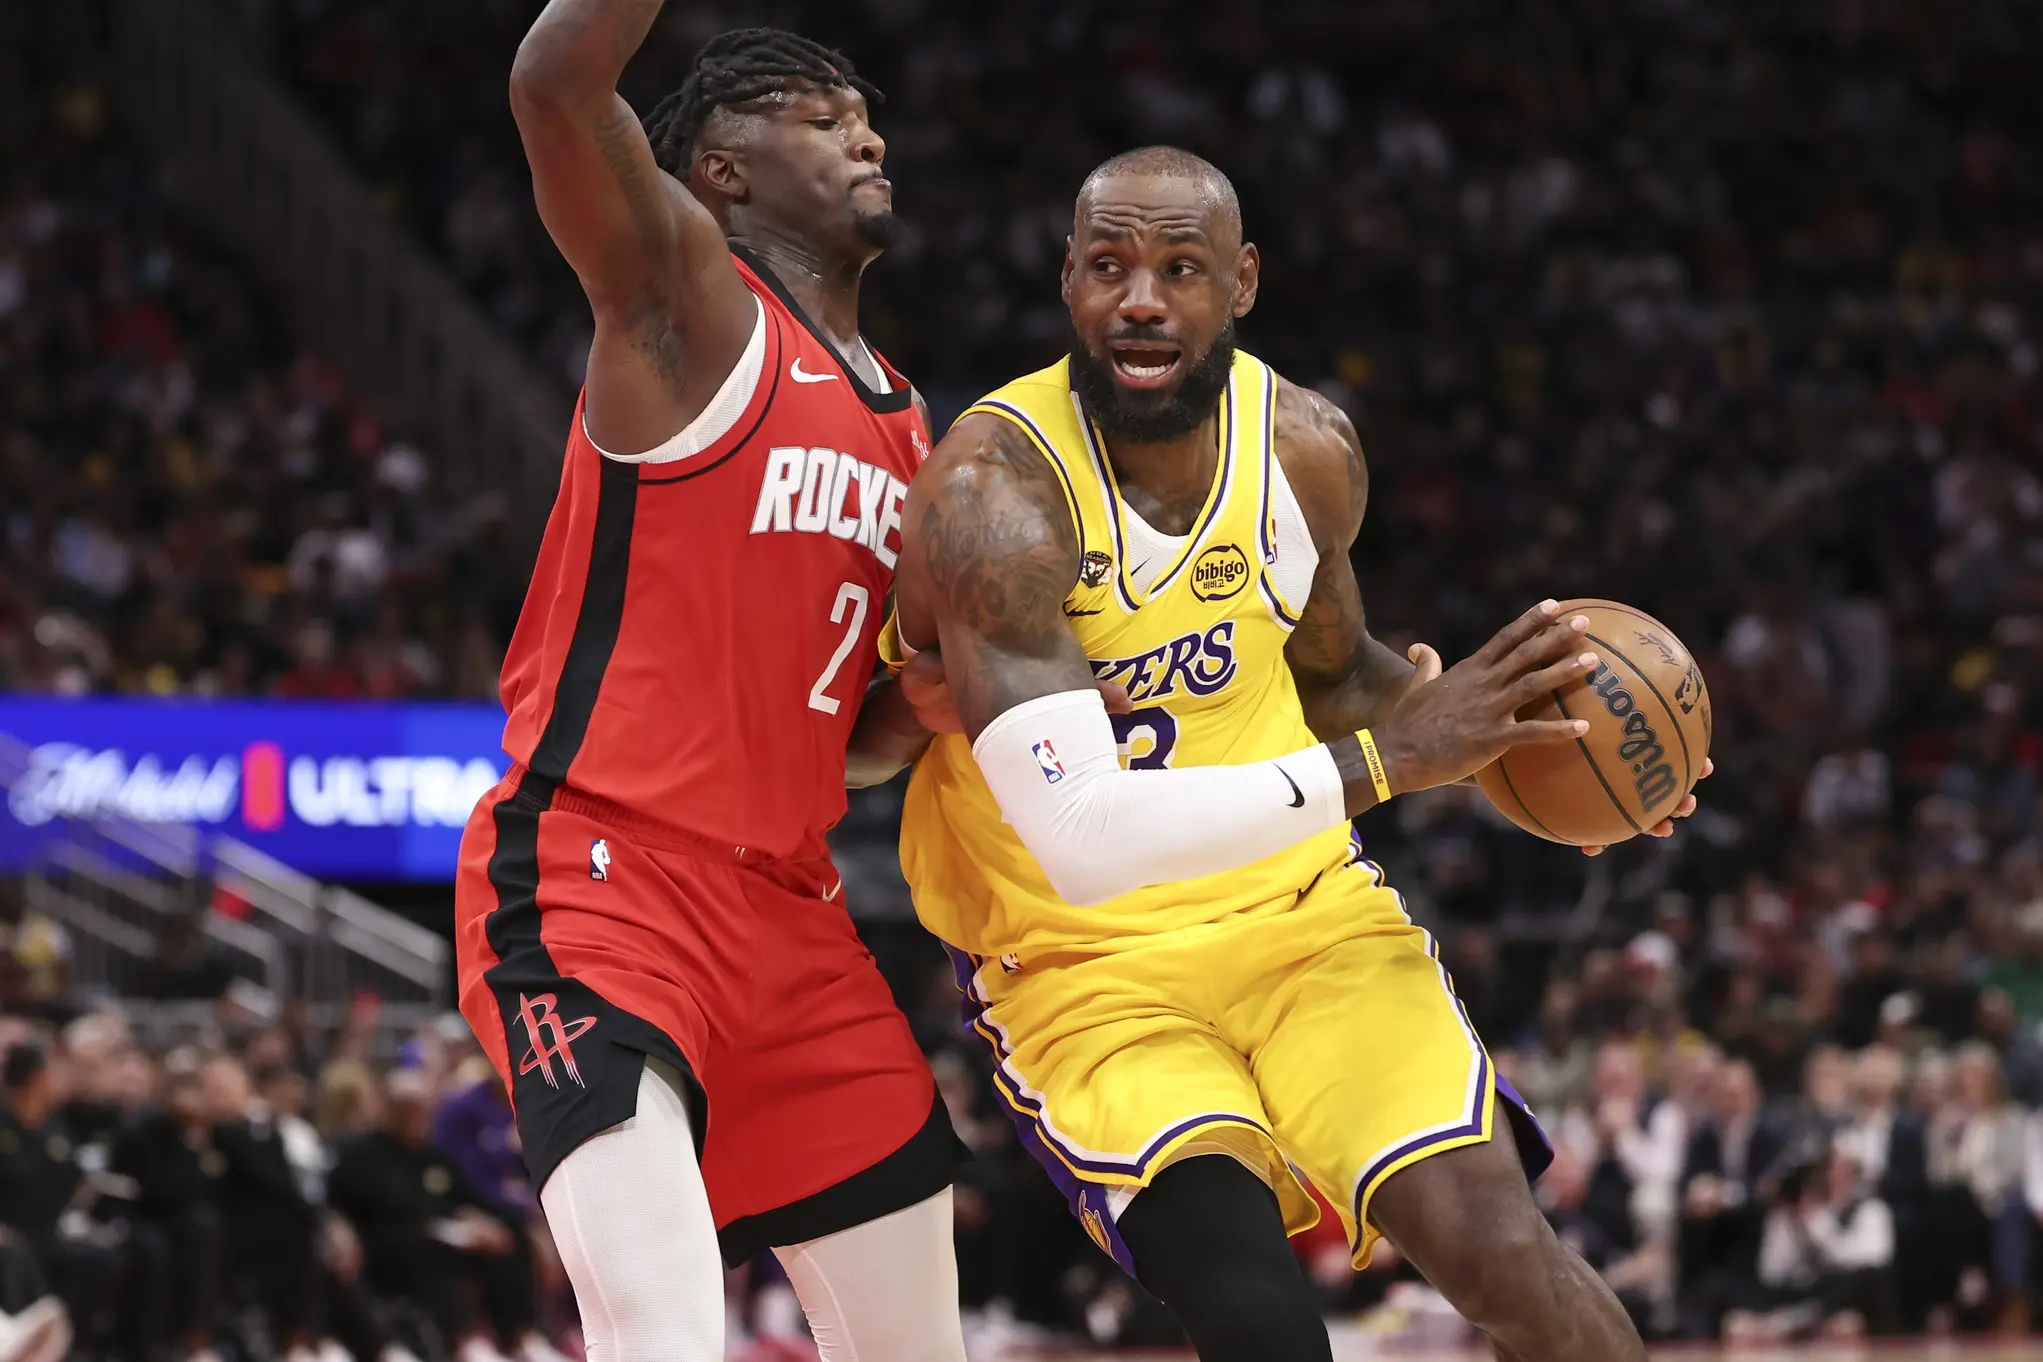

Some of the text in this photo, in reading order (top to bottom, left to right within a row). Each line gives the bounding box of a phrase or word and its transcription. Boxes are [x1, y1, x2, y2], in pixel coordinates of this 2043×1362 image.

[749, 446, 908, 571] ROCKE
[1195, 559, 1245, 582] bibigo
[1203, 578, 1225, 590] 비비고
[808, 581, 869, 715] 2
[1365, 745, 1384, 785] PROMISE
[1585, 658, 1678, 814] Wilson
